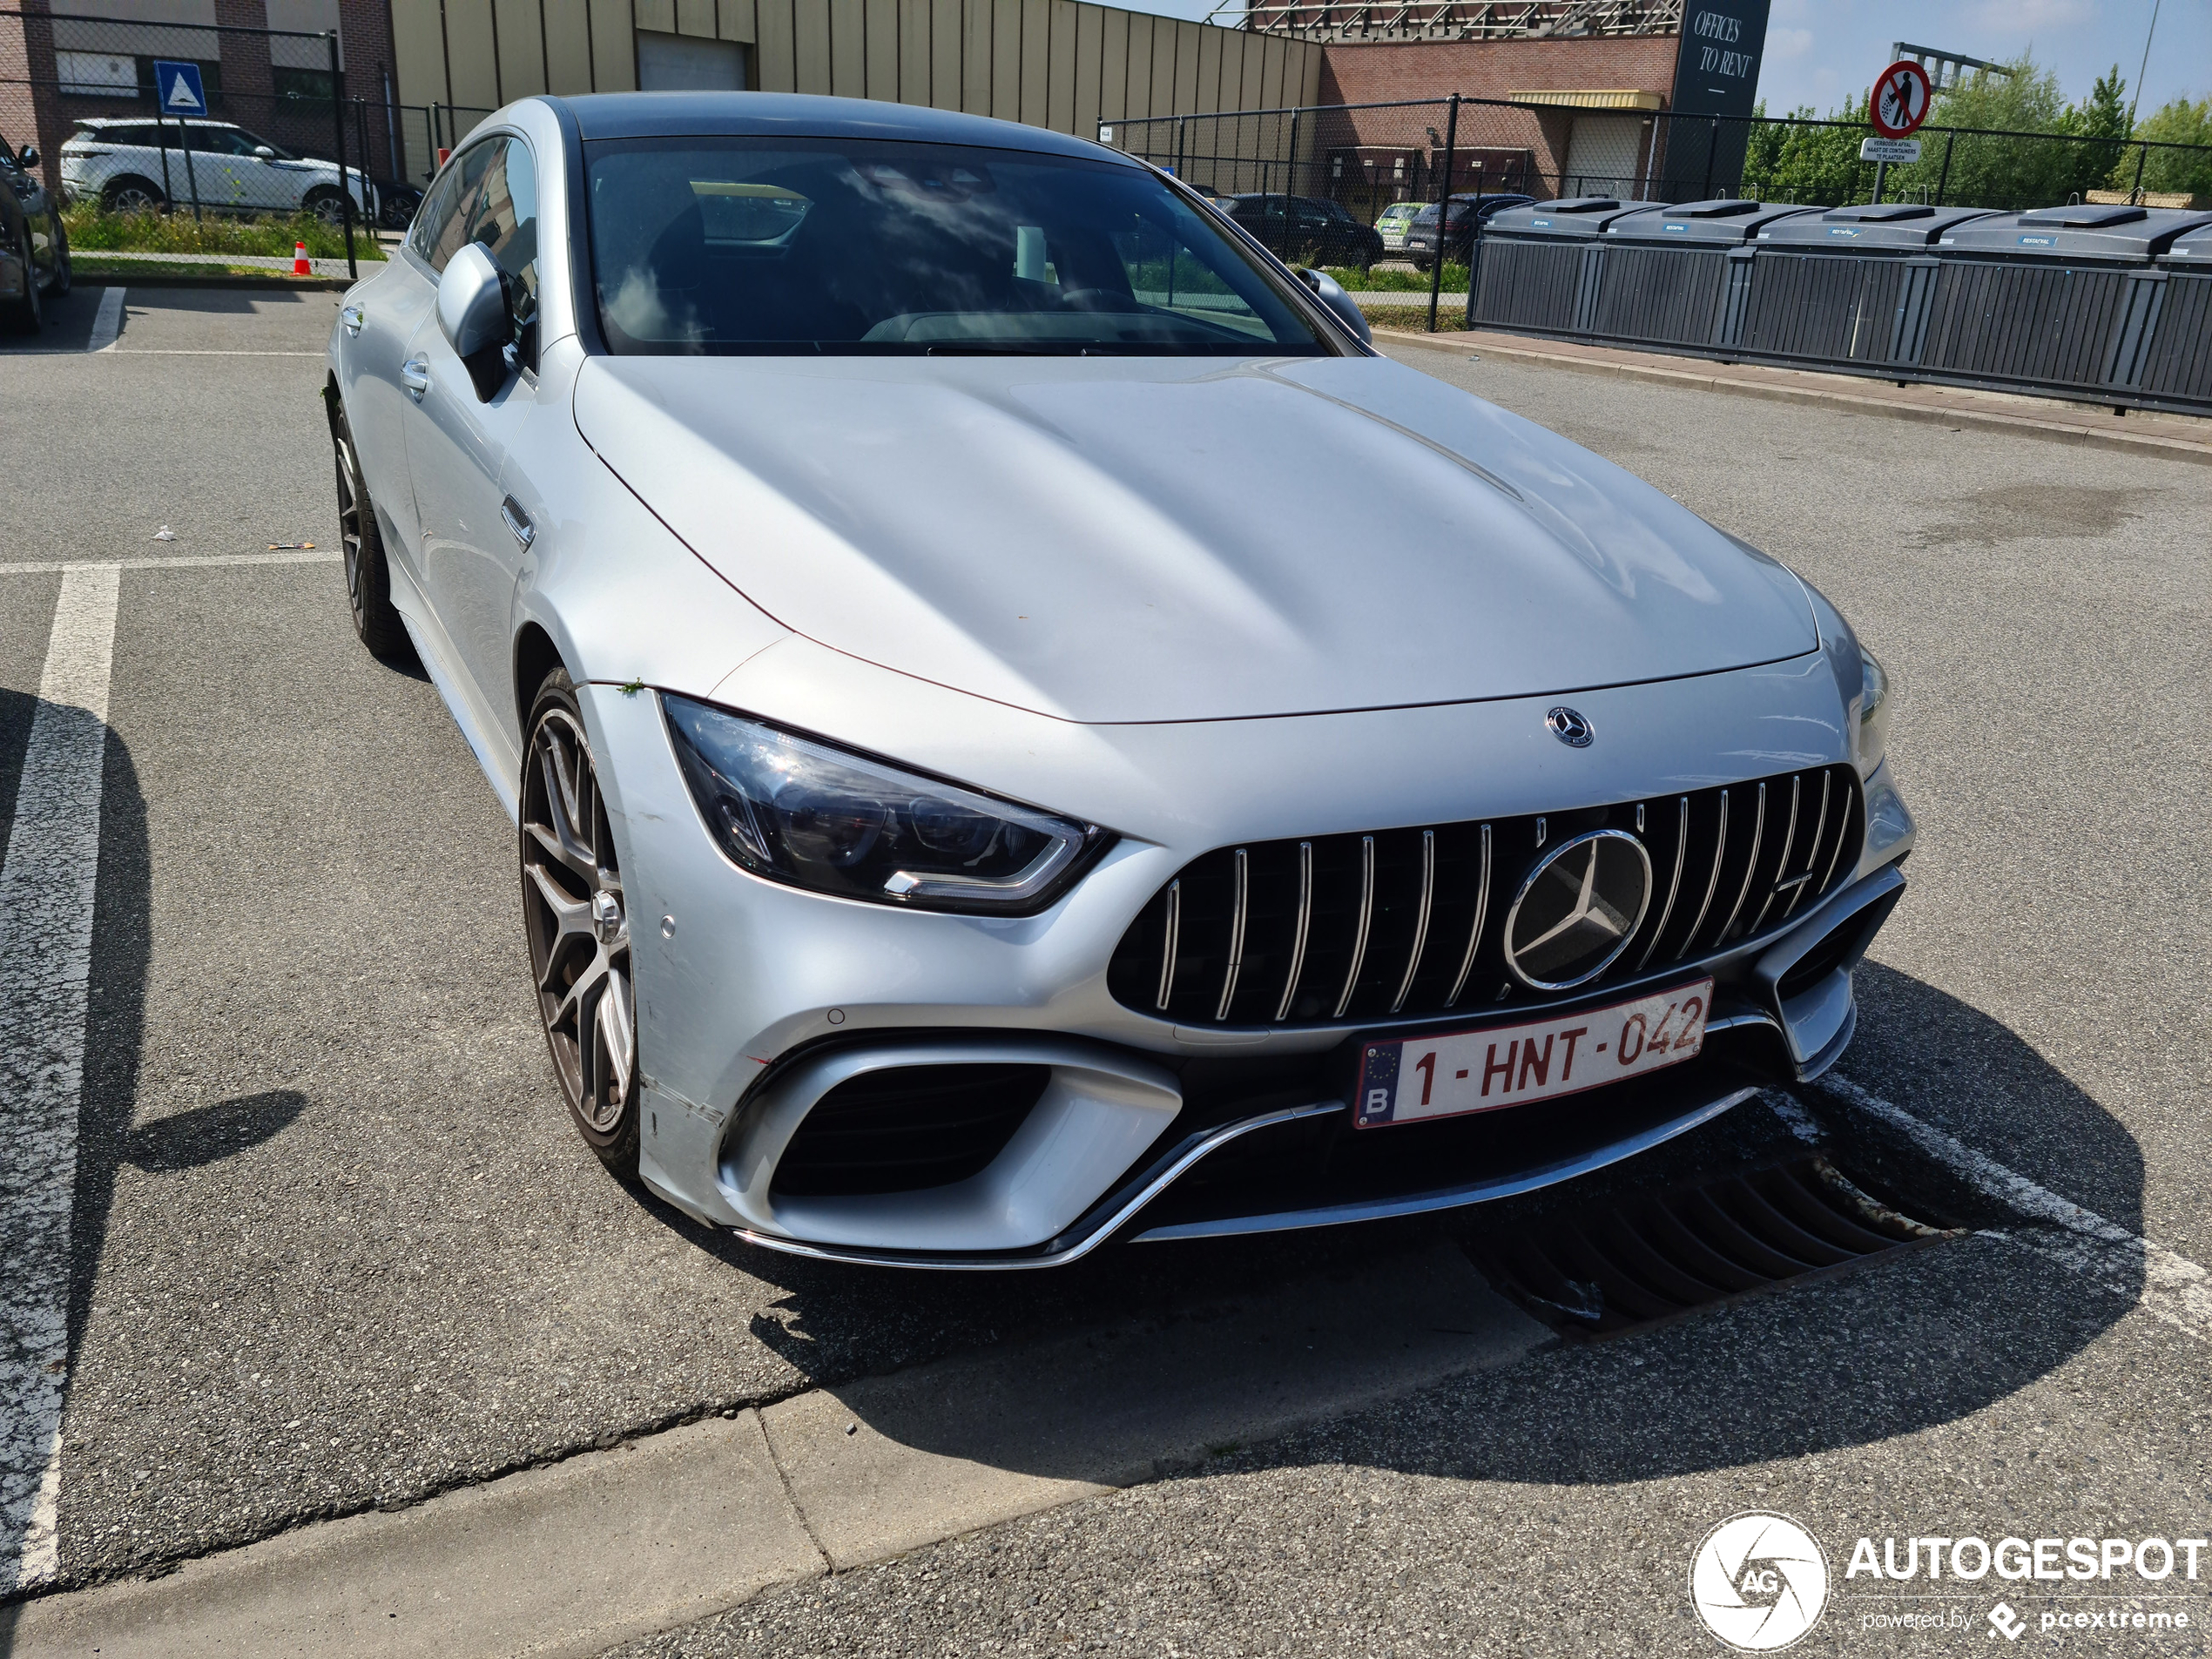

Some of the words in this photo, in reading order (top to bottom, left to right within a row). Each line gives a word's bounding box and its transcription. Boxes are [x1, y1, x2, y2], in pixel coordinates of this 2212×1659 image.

[1695, 10, 1742, 43] OFFICES
[1700, 46, 1718, 71] TO
[1719, 51, 1753, 78] RENT
[1366, 1089, 1388, 1114] B
